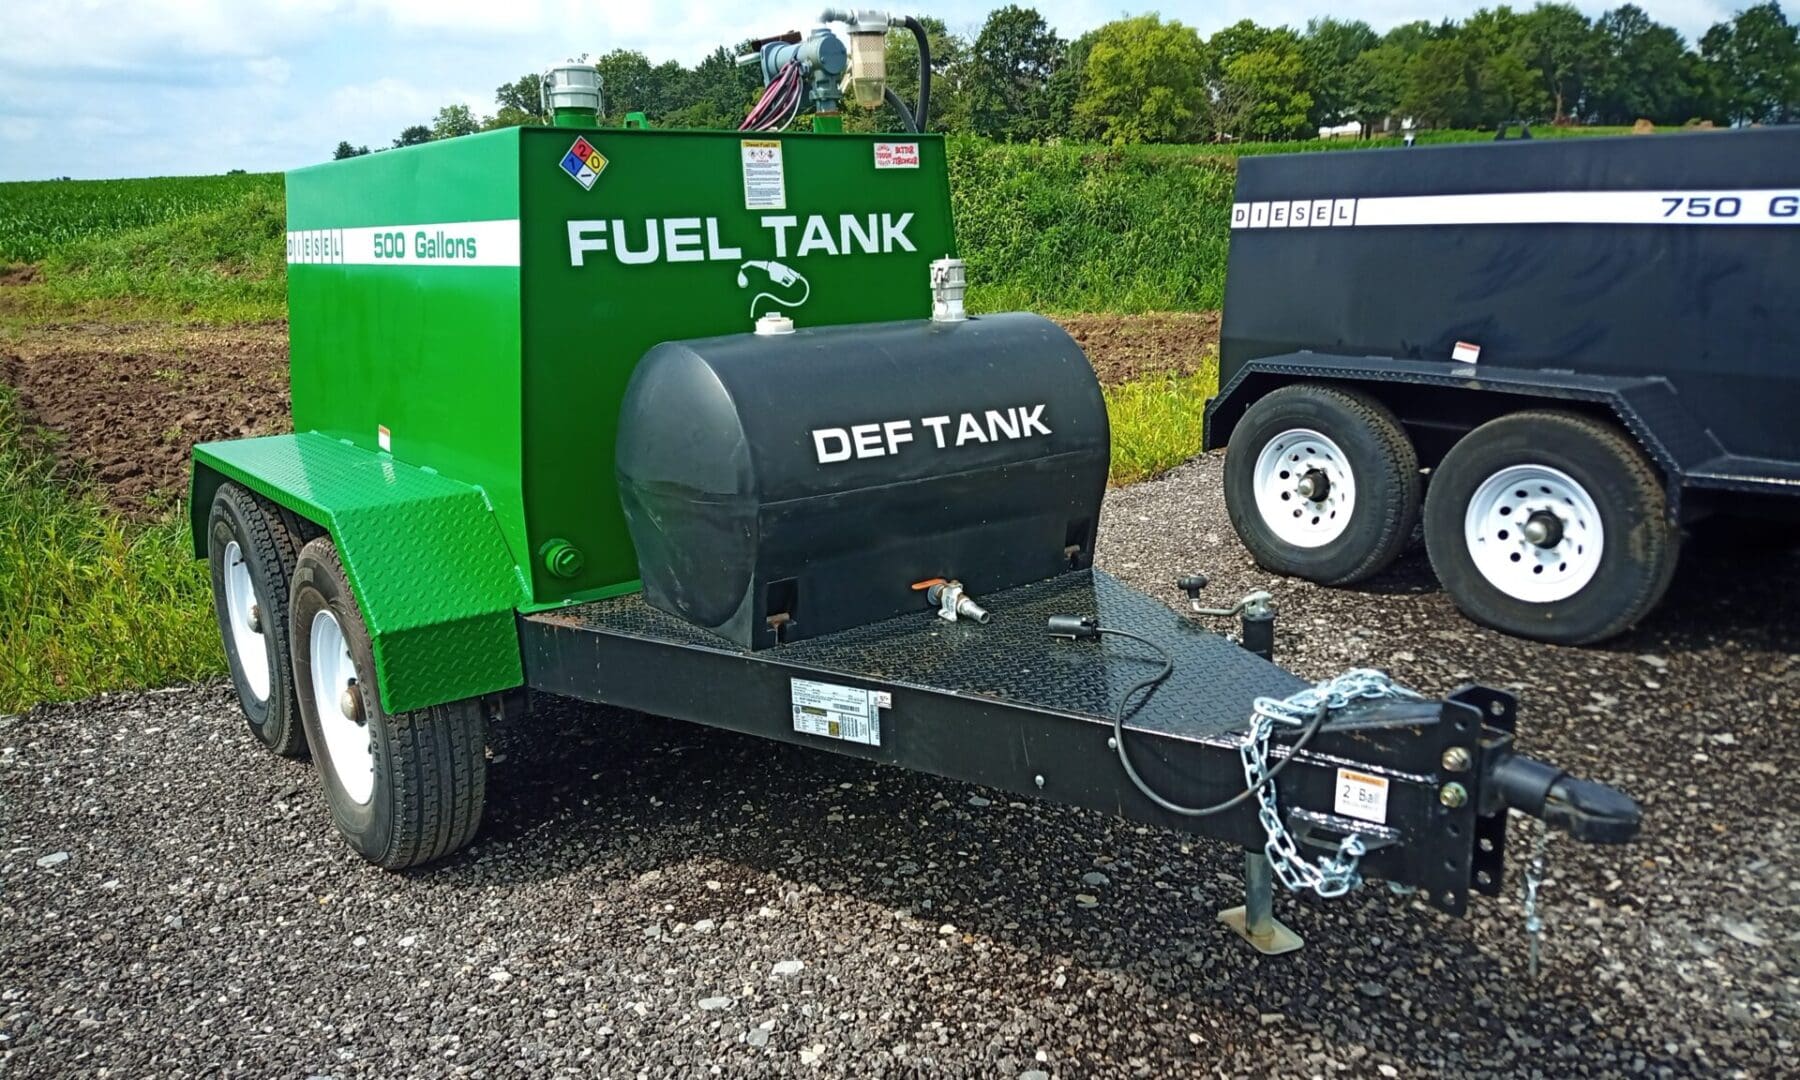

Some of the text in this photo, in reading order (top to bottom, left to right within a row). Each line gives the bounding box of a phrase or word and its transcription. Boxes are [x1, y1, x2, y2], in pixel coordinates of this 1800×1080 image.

[578, 144, 587, 157] 2
[569, 156, 601, 170] 1 0
[1236, 206, 1348, 222] DIESEL
[1661, 197, 1742, 217] 750
[287, 231, 477, 259] DIESEL 500 Gallons
[567, 212, 918, 266] FUEL TANK
[812, 404, 1053, 464] DEF TANK
